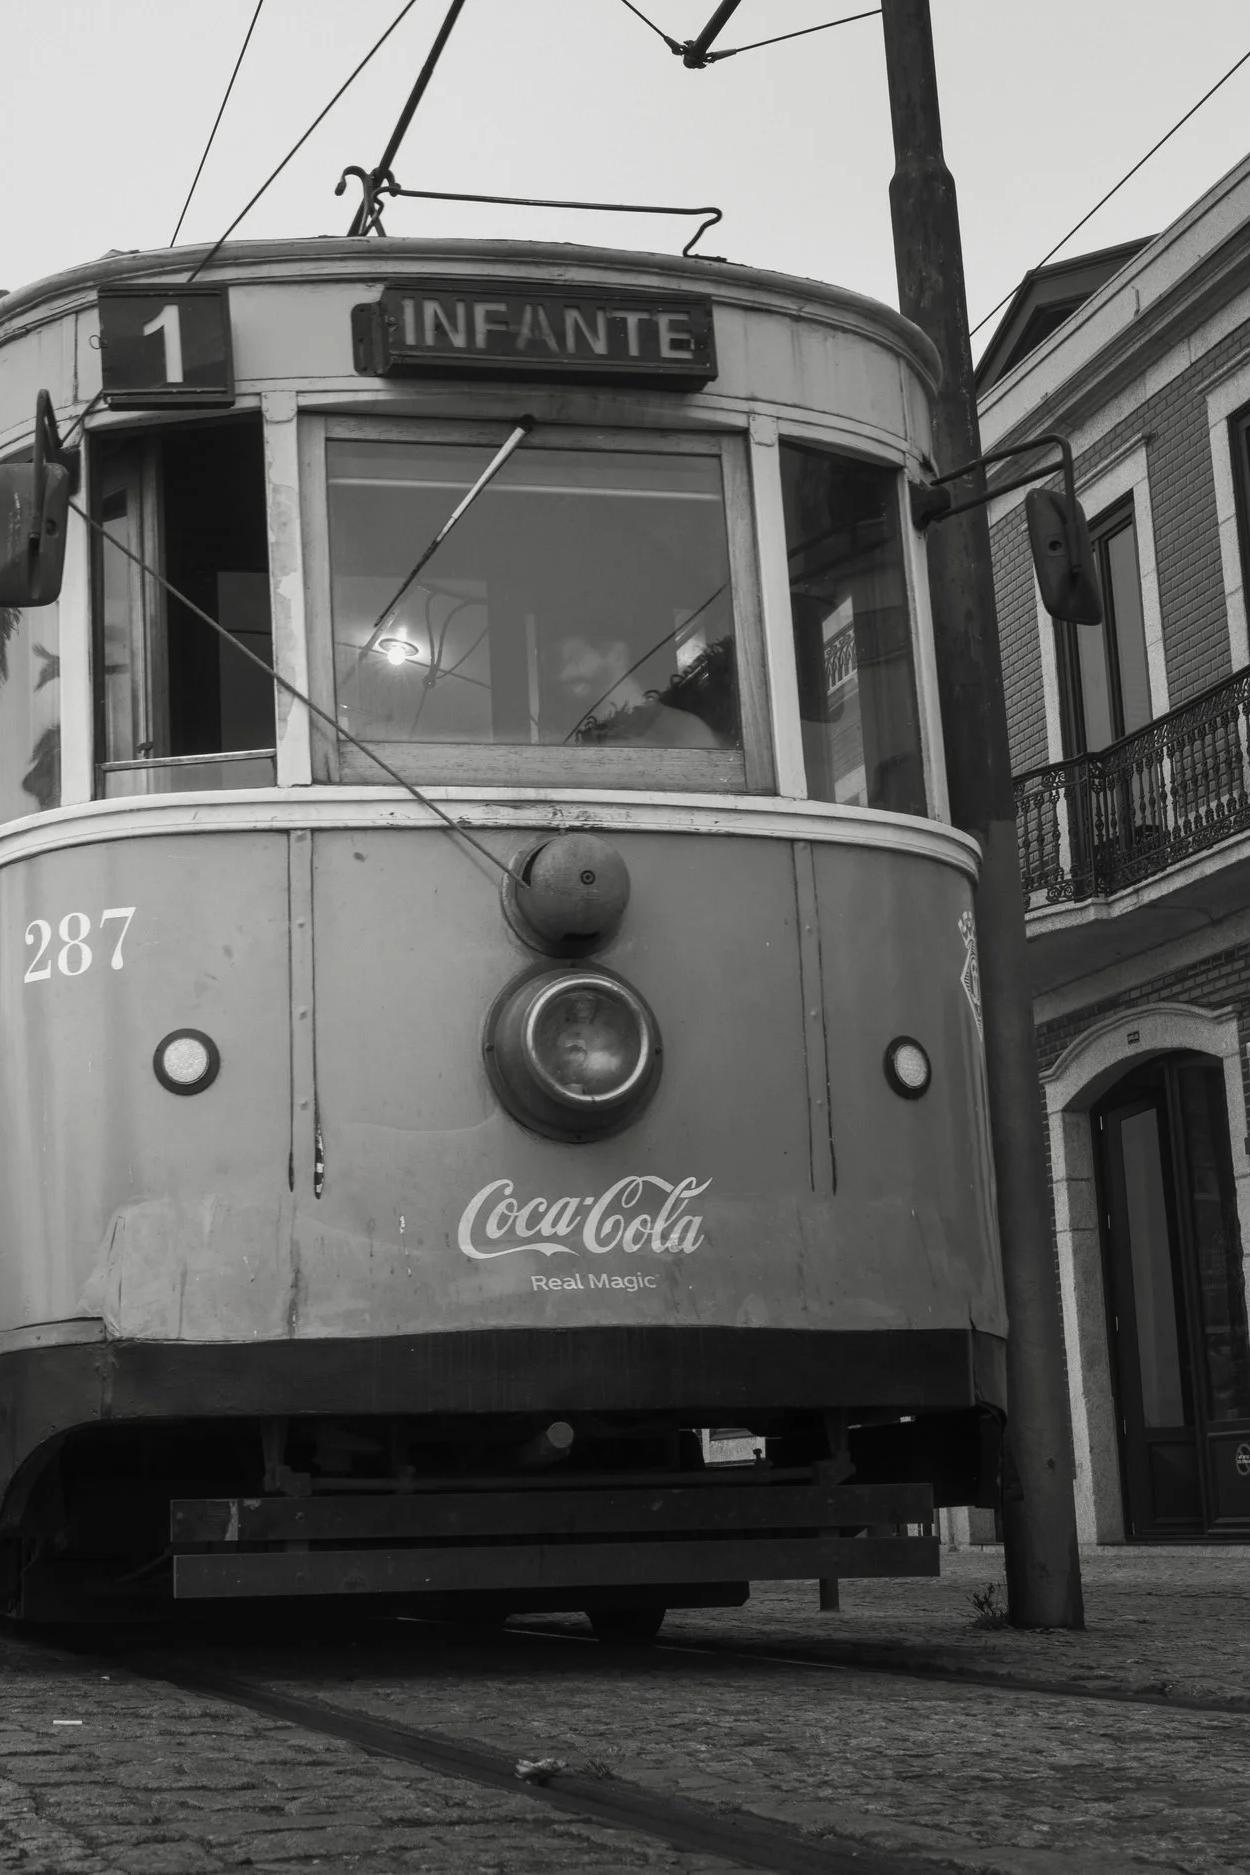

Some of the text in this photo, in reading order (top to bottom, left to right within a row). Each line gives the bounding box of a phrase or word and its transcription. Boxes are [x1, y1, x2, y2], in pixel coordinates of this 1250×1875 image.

[143, 303, 184, 384] 1
[402, 296, 695, 360] INFANTE
[23, 906, 137, 984] 287
[457, 1175, 713, 1260] Coca-Cola
[530, 1271, 657, 1292] Real Magic
